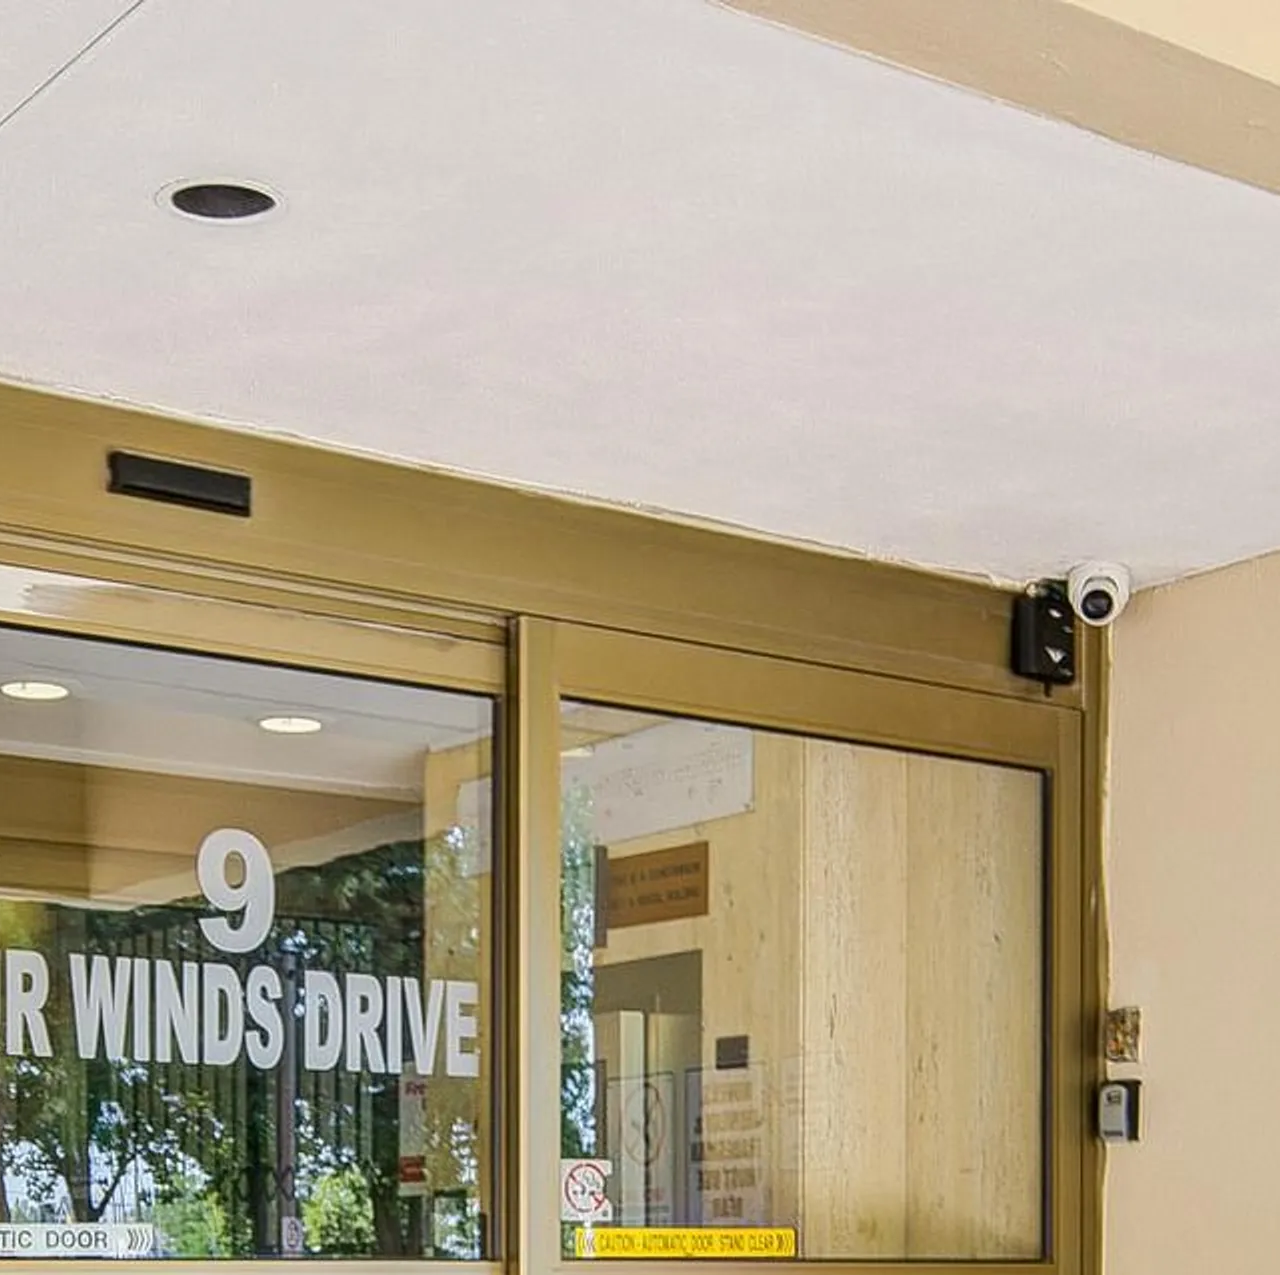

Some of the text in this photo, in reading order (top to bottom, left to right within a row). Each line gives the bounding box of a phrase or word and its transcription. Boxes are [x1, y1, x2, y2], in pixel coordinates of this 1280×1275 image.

[196, 828, 274, 952] 9
[70, 953, 284, 1070] WINDS
[303, 970, 479, 1077] DRIVE
[46, 1230, 108, 1249] DOOR
